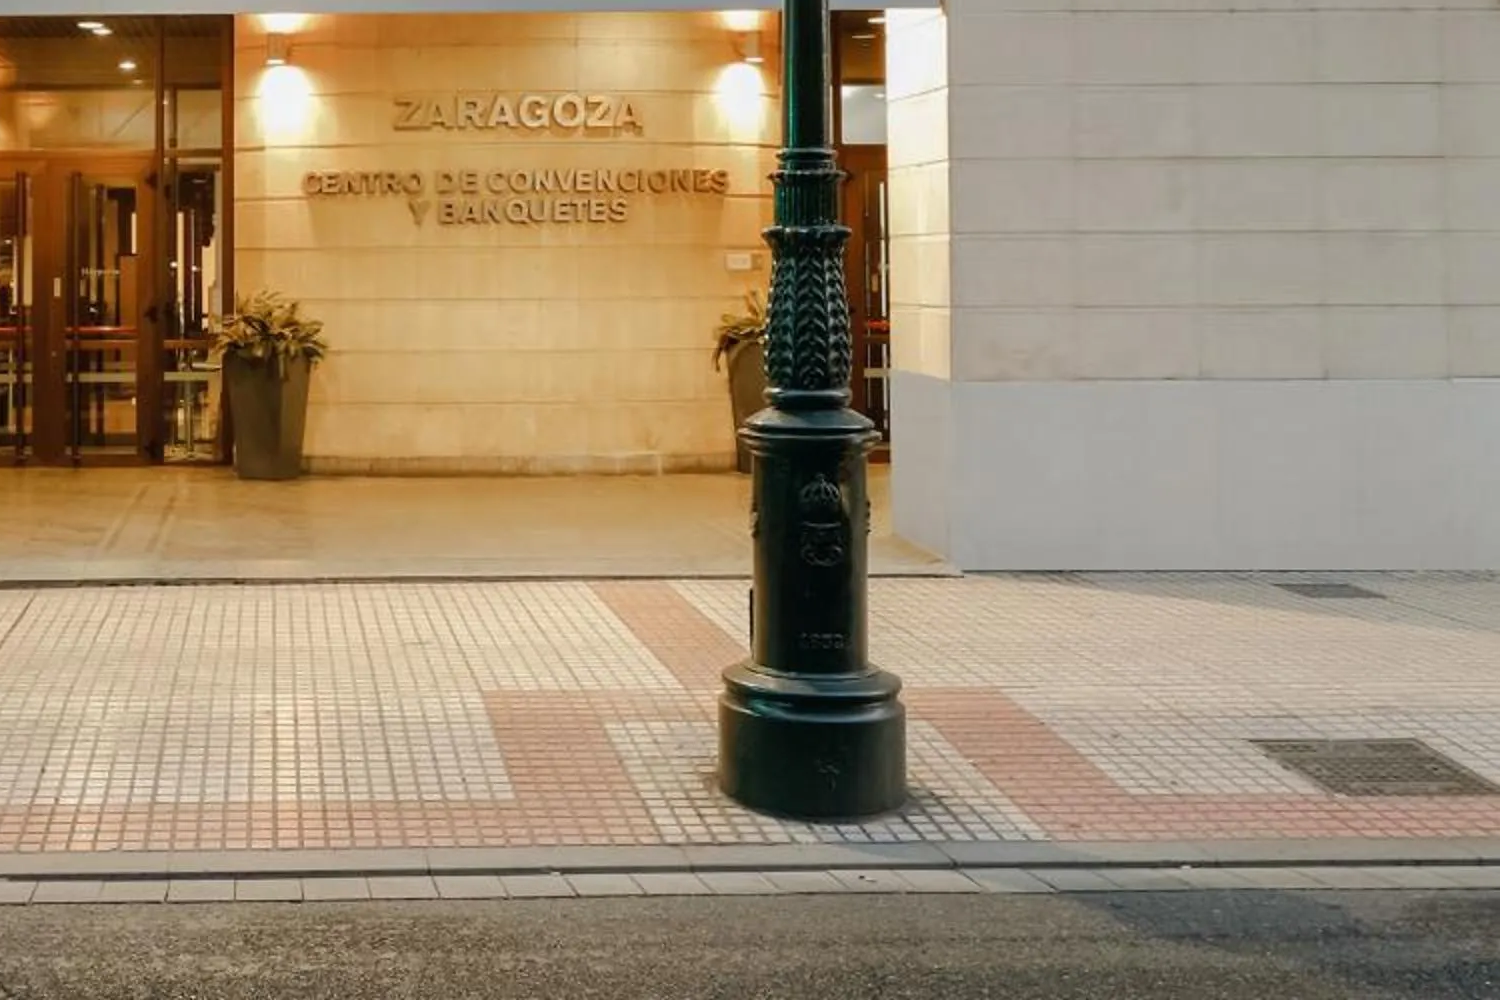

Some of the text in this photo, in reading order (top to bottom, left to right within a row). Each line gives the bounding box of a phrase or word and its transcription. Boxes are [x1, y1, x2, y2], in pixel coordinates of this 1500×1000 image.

[396, 94, 642, 132] ZARAGOZA
[304, 168, 730, 195] CENTRO DE CONVENCIONES
[406, 196, 629, 226] Y BANQUETES
